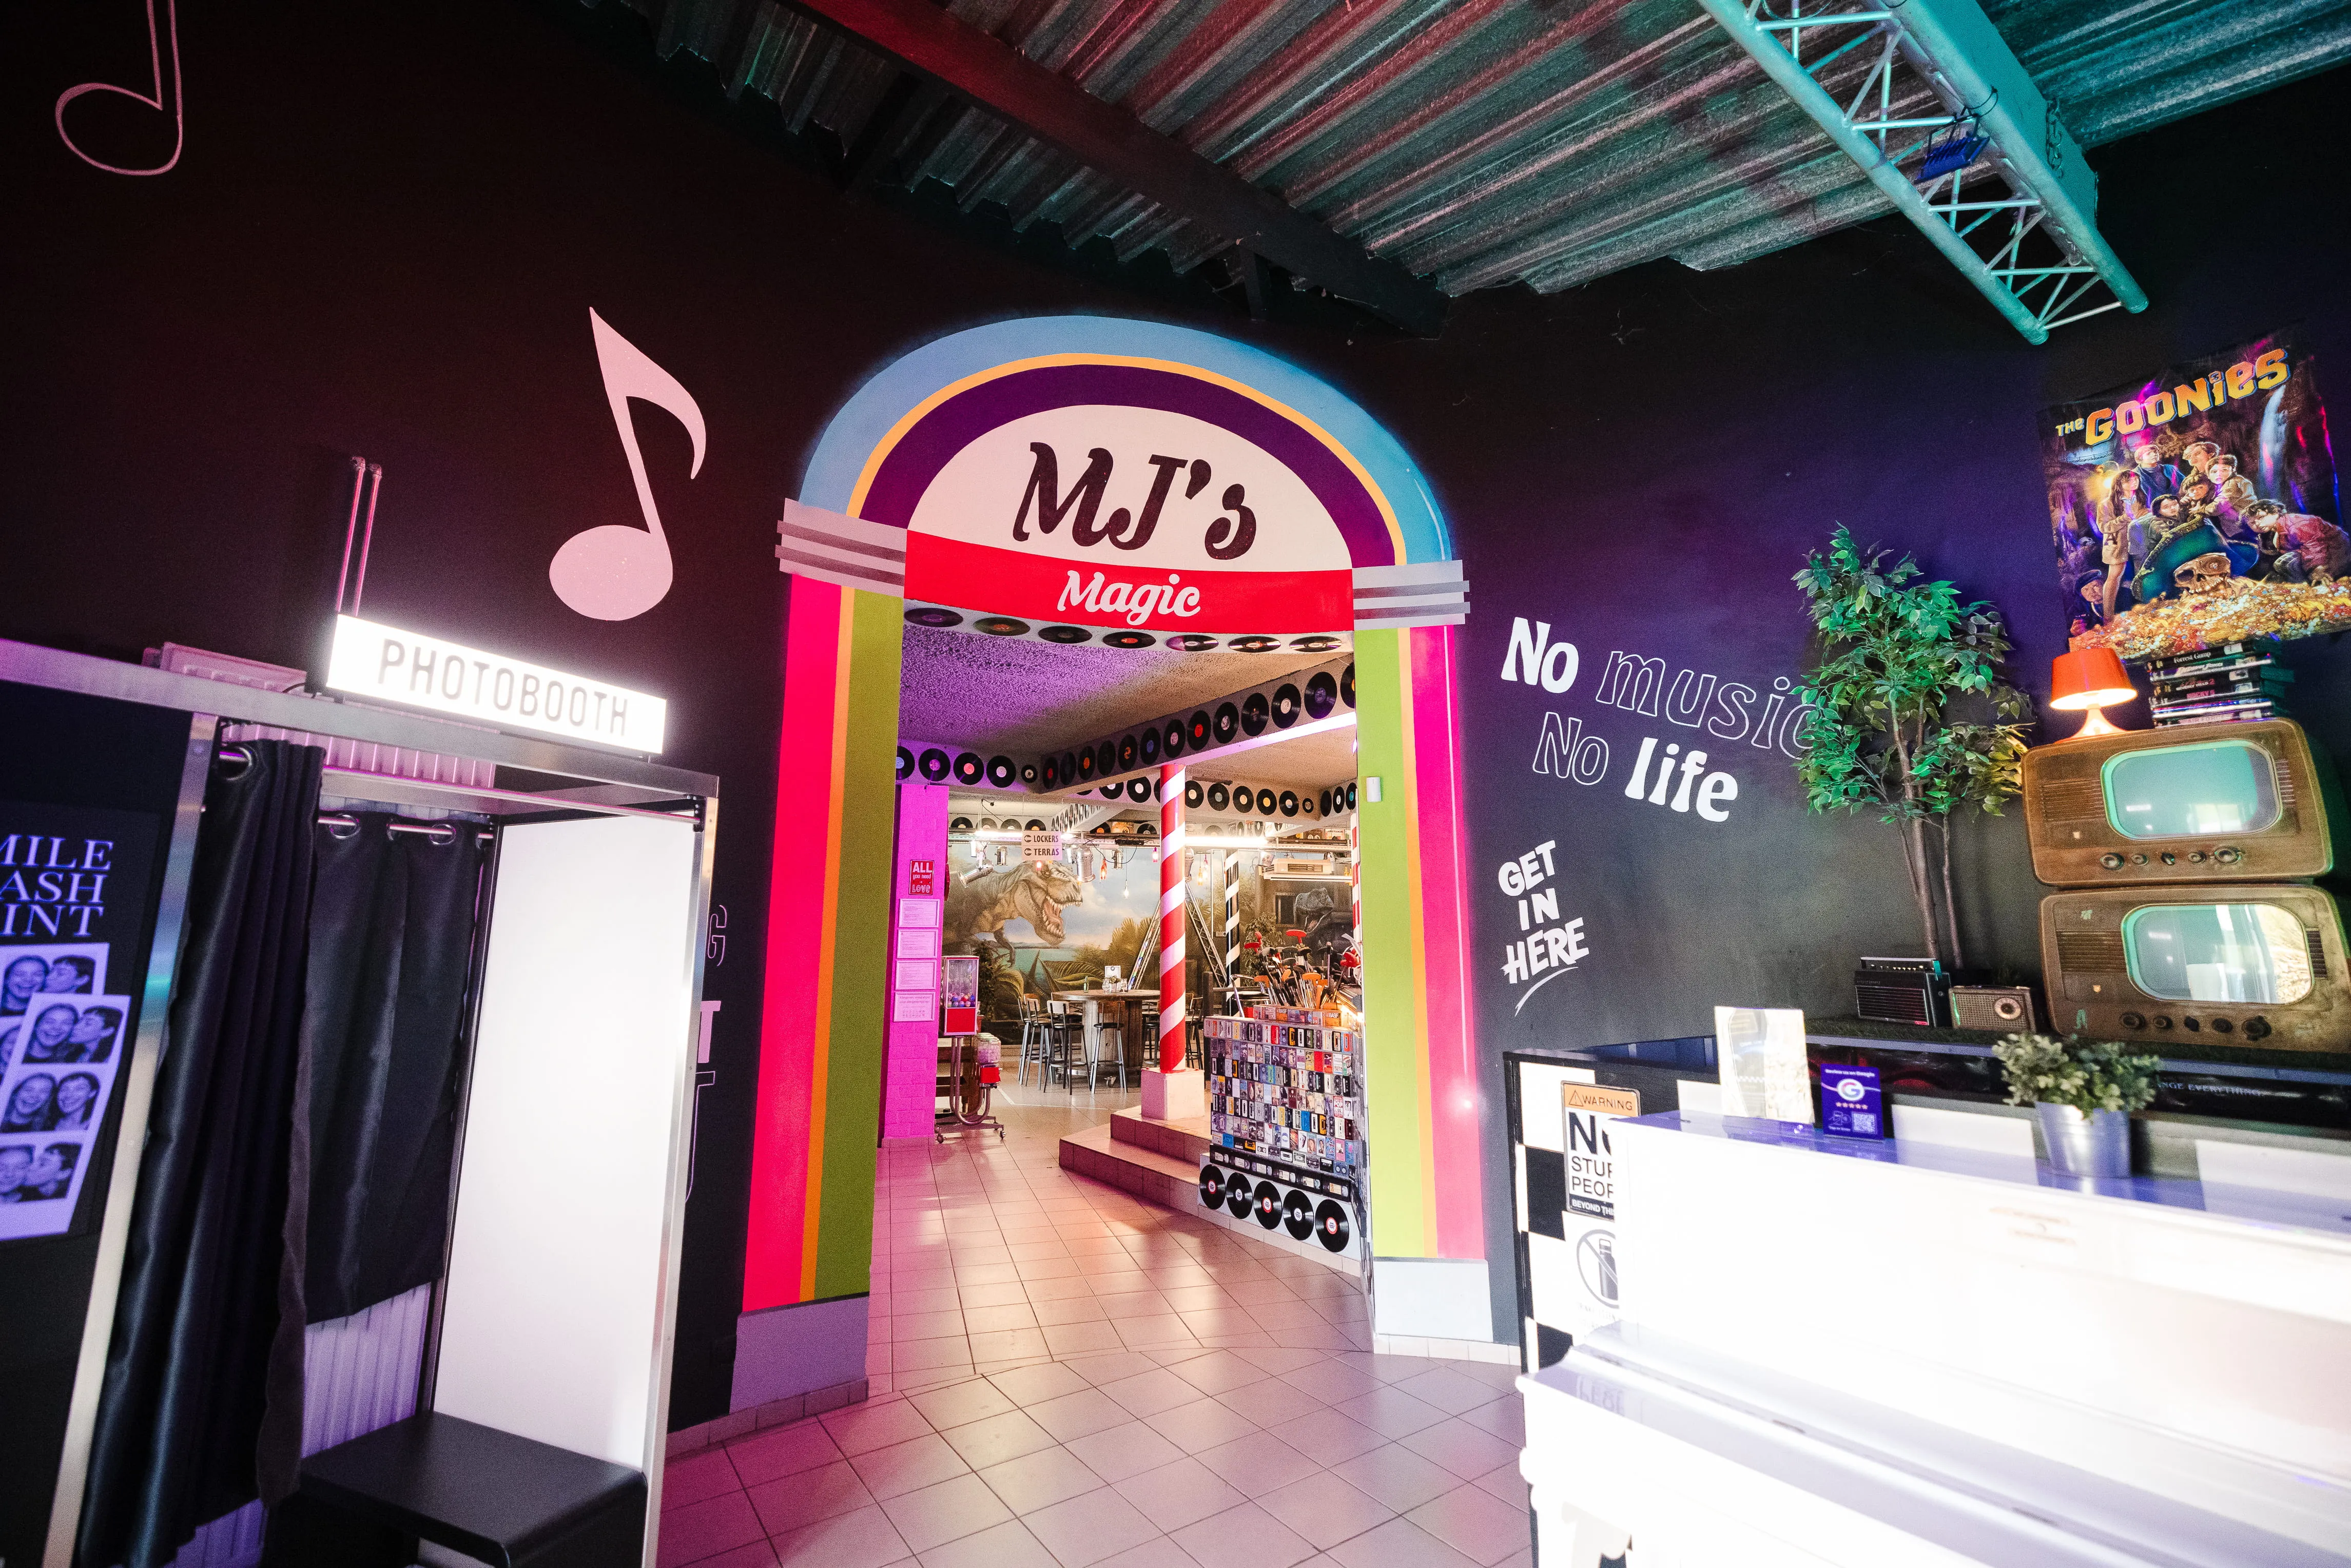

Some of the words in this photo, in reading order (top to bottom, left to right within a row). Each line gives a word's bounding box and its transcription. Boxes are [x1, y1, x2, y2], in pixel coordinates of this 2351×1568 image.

[1013, 442, 1257, 560] MJ's
[1057, 570, 1201, 626] Magic
[1501, 616, 1579, 693] No
[377, 638, 629, 737] PHOTOBOOTH
[1532, 711, 1609, 786] No
[1625, 737, 1738, 822] life
[912, 862, 932, 873] ALL
[1034, 848, 1059, 856] TERRAS
[1498, 840, 1556, 897] GET
[1518, 888, 1560, 931] IN
[1500, 917, 1589, 984] HERE
[1582, 1095, 1633, 1111] WARNING
[1571, 1198, 1601, 1213] BEYOND
[1601, 1205, 1614, 1216] THI
